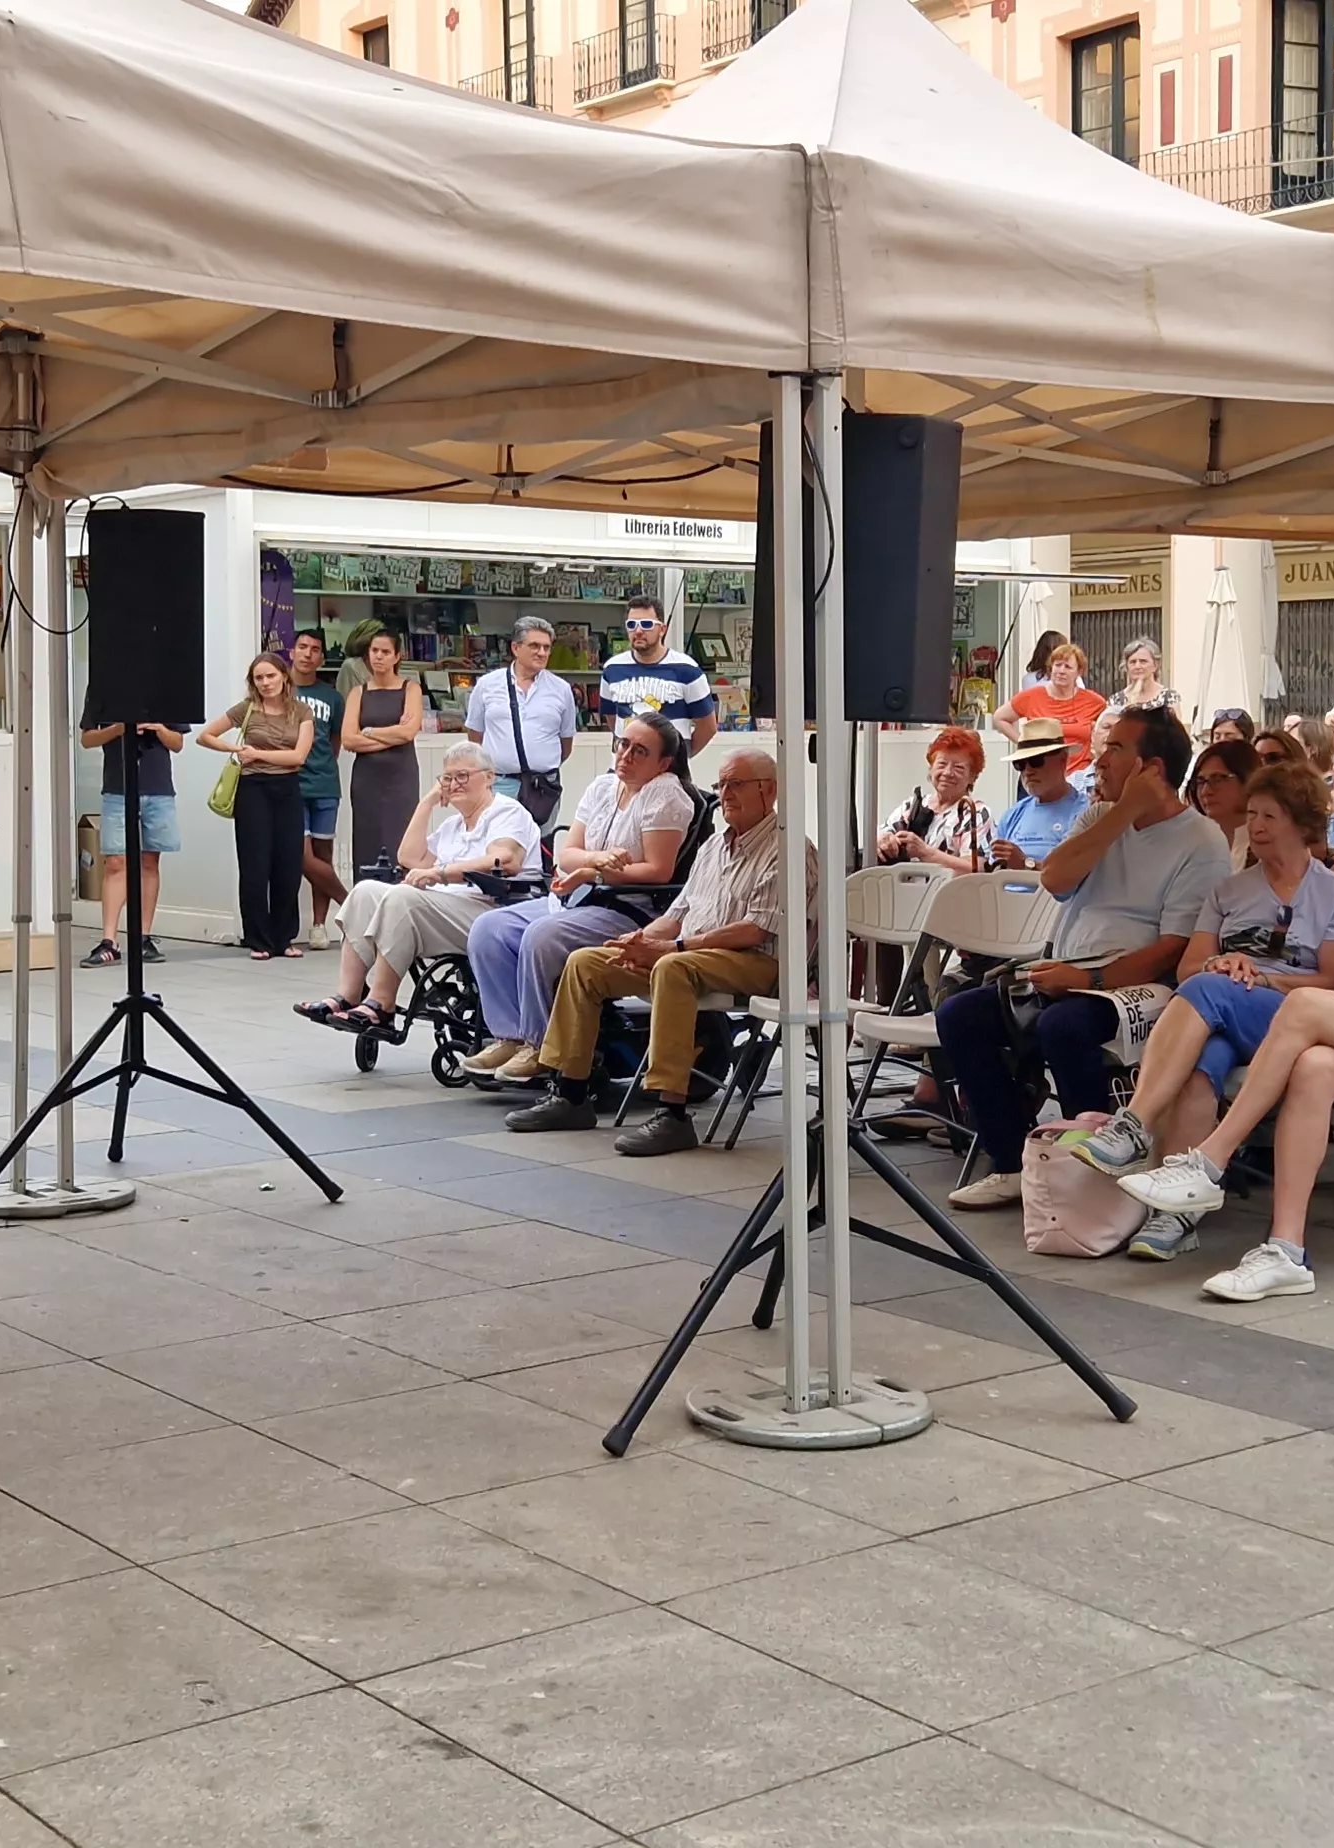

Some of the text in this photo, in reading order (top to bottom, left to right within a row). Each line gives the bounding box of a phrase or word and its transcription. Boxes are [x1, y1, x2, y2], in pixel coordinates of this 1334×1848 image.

[625, 518, 723, 539] Librería Edelweis
[1114, 987, 1156, 1006] LIBRO
[1126, 1004, 1145, 1026] DE
